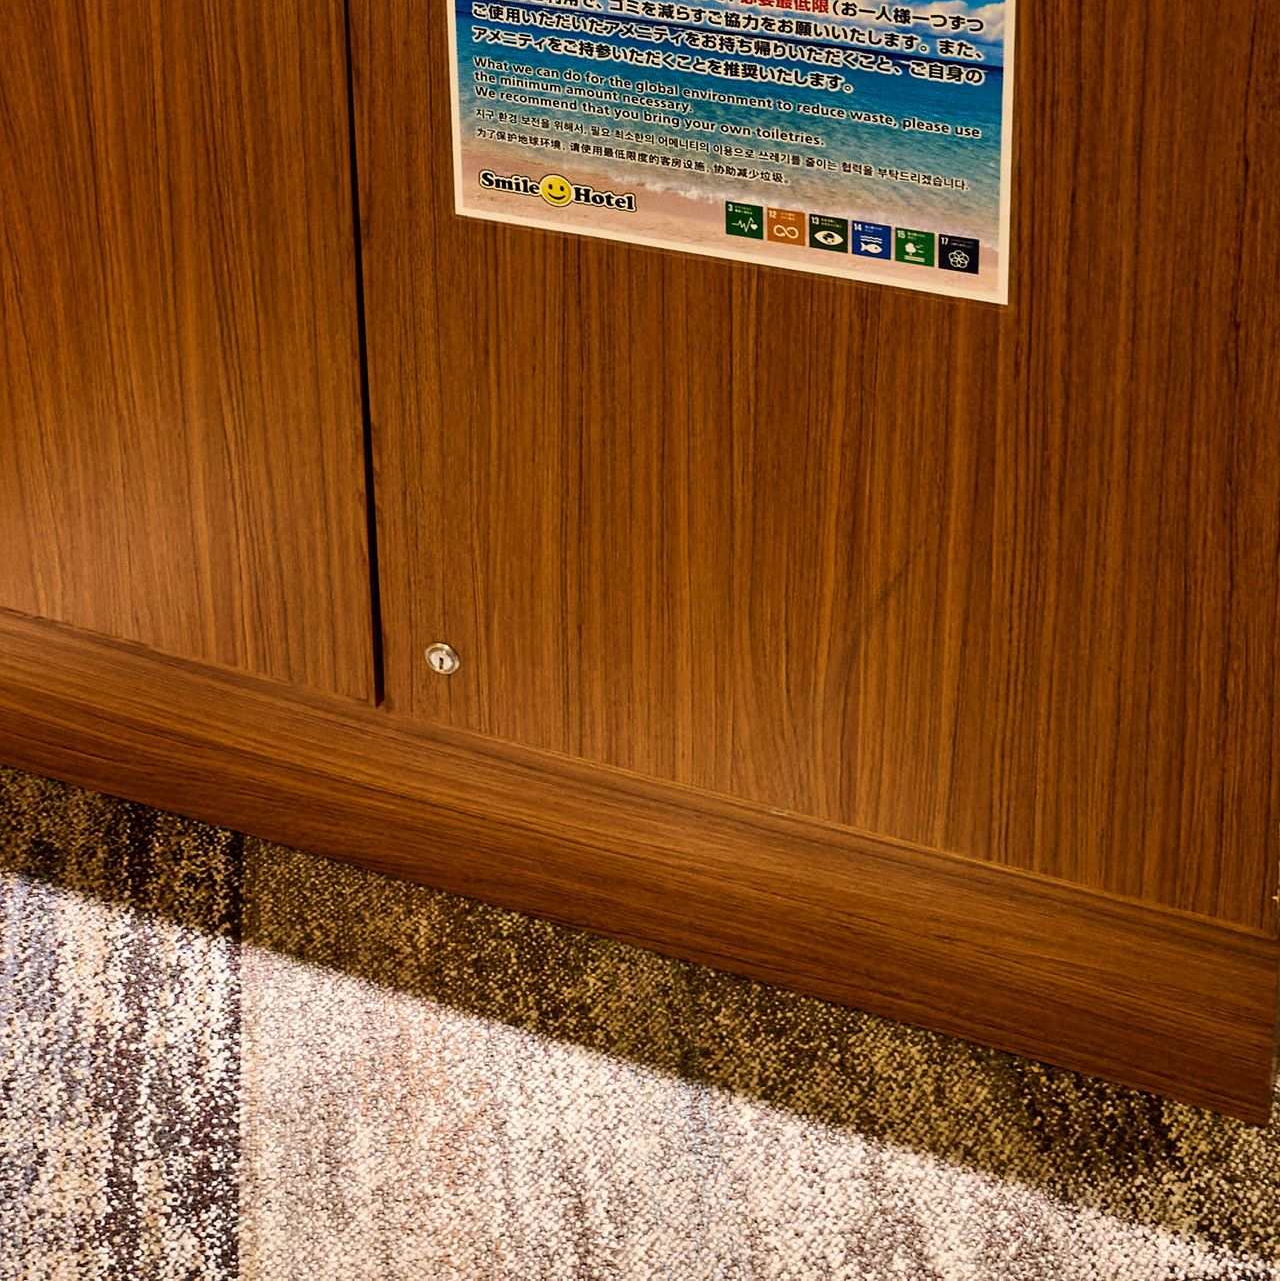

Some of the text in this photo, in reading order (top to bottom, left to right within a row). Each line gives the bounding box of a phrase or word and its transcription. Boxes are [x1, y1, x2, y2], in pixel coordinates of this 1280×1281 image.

[472, 26, 853, 93] アメニティをご持参いただくことを推奨いたします。
[474, 70, 692, 114] the minimum amount necessary.
[474, 56, 980, 137] What we can do for the global environment to reduce waste, please use
[475, 86, 824, 147] We recommend that you bring your own toiletries.
[475, 108, 494, 121] 지구
[498, 111, 517, 124] 환경
[521, 115, 550, 129] 보전을
[590, 125, 610, 138] 필요
[613, 128, 654, 144] 최소한의
[657, 135, 708, 153] 어메니티의
[713, 143, 754, 159] 이용으로
[758, 150, 800, 166] 쓰레기를
[805, 156, 837, 172] 줄이는
[841, 162, 873, 177] 협력을
[877, 167, 969, 191] 부탁드리겠습니다.
[479, 171, 635, 211] Smile Hotel
[727, 204, 733, 212] 3
[768, 210, 777, 219] 12
[811, 216, 820, 225] 13
[854, 223, 862, 231] 14
[941, 237, 949, 245] 17
